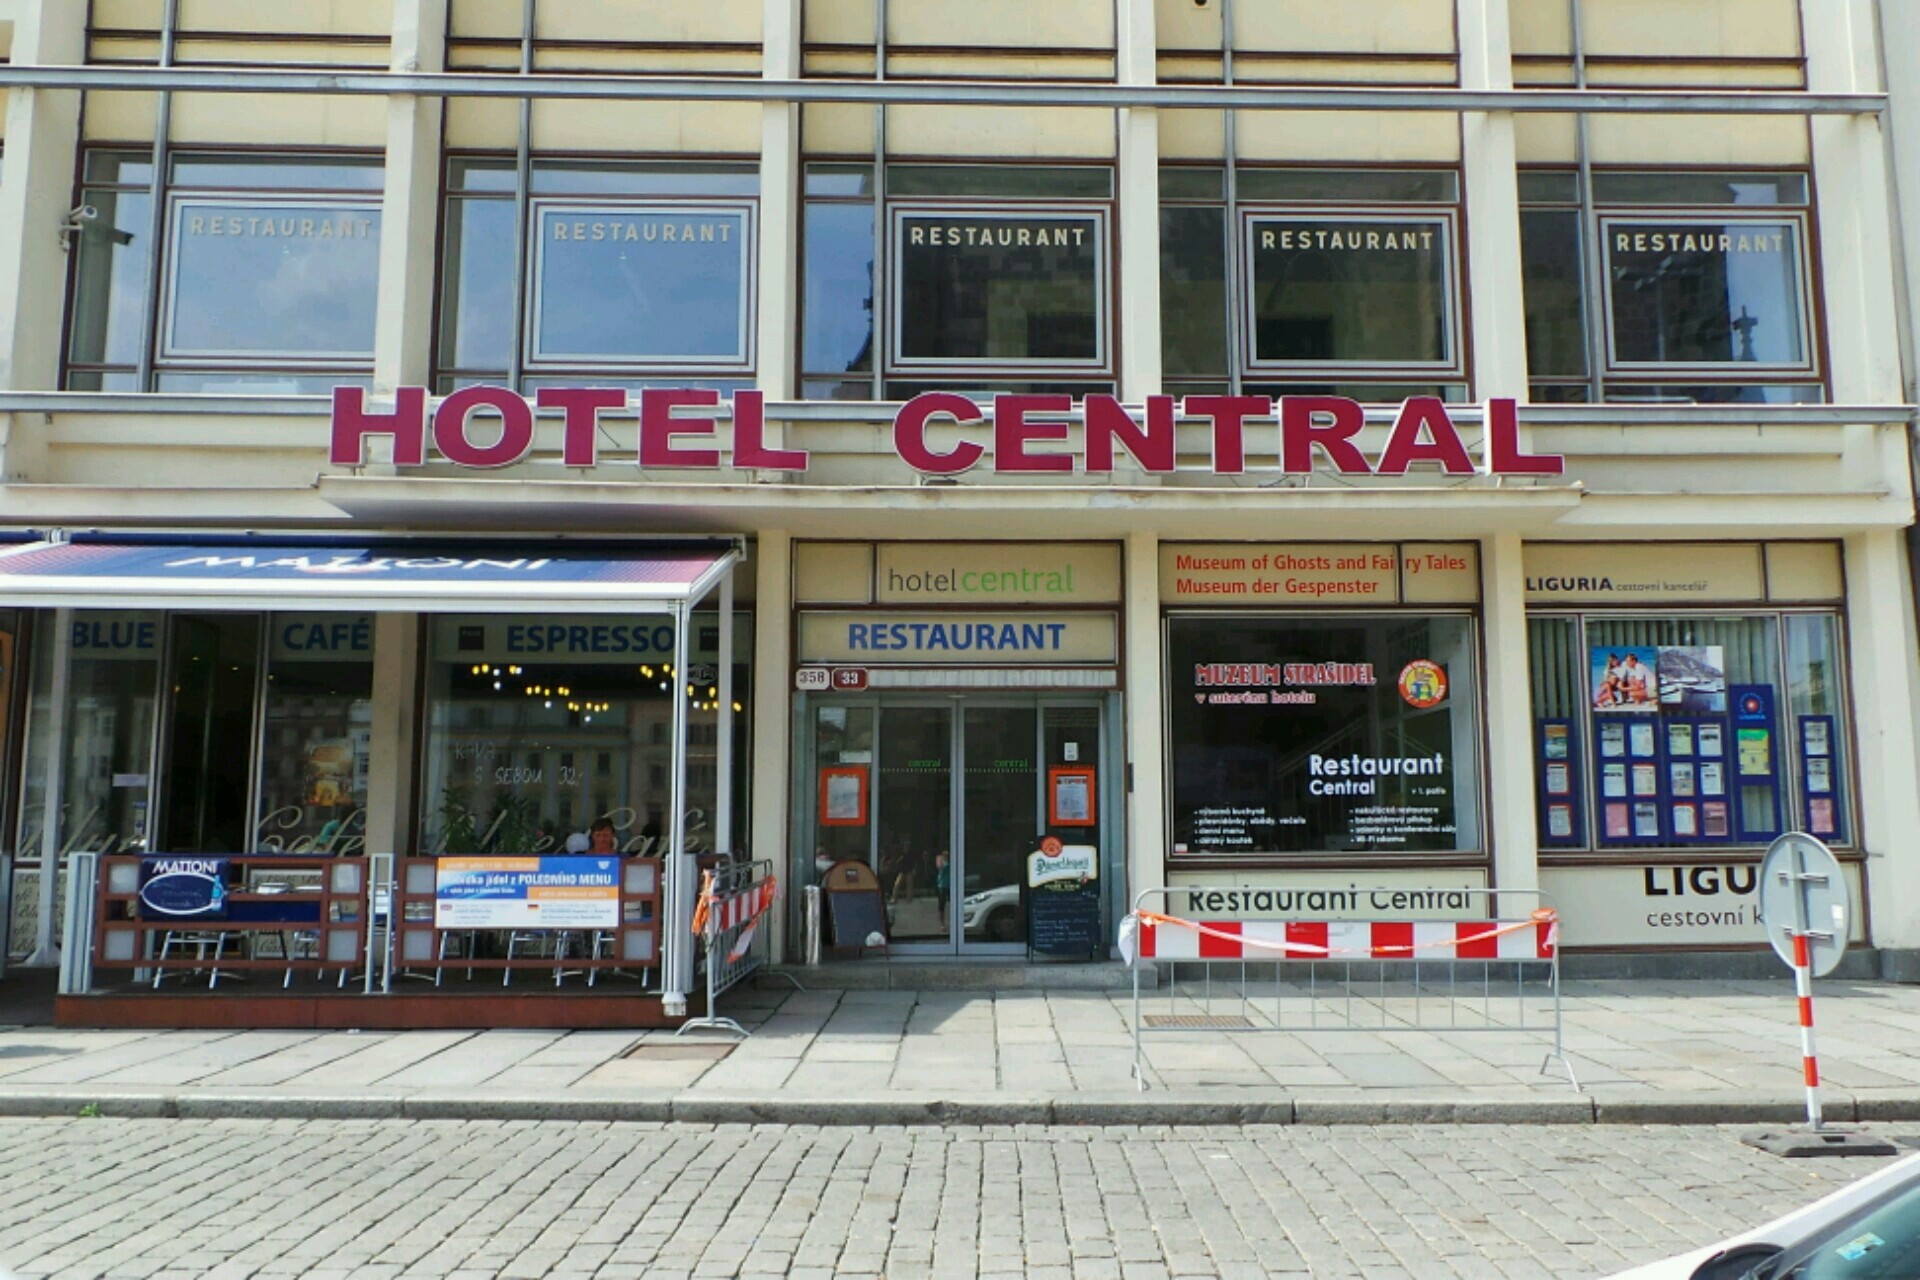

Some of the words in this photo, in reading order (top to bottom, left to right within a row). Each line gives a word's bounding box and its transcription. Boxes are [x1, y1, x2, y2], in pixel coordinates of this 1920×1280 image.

[190, 216, 372, 238] RESTAURANT
[553, 222, 733, 243] RESTAURANT
[910, 226, 1086, 246] RESTAURANT
[1261, 230, 1434, 250] RESTAURANT
[1615, 233, 1785, 253] RESTAURANT
[329, 384, 809, 471] HOTEL
[893, 391, 1565, 477] CENTRAL
[1176, 555, 1246, 570] Museum
[1251, 554, 1269, 570] of
[1273, 554, 1332, 570] Ghosts
[1336, 554, 1366, 570] and
[1425, 554, 1467, 570] Tales
[888, 567, 957, 592] hotel
[961, 564, 1075, 593] central
[1176, 578, 1247, 593] Museum
[1252, 577, 1279, 593] der
[1284, 578, 1379, 597] Gespenster
[1526, 577, 1614, 591] LIGURIA
[71, 621, 155, 649] BLUE
[283, 617, 371, 651] CAFÉ
[506, 625, 675, 653] ESPRESSO
[848, 623, 1067, 650] RESTAURANT
[799, 671, 826, 686] 358
[1195, 663, 1282, 686] MUZEUM
[1283, 661, 1377, 686] STRAŠIDEL
[1195, 693, 1206, 704] v
[1271, 690, 1317, 704] hotelu
[993, 758, 1029, 768] central
[1310, 753, 1444, 776] Restaurant
[1309, 779, 1376, 796] Central
[151, 860, 219, 875] MATTONI
[578, 873, 612, 886] MENU
[1644, 866, 1758, 896] LIGU
[1188, 884, 1358, 912] Restaurant
[1369, 885, 1471, 911] Central
[1646, 904, 1744, 927] cestovní
